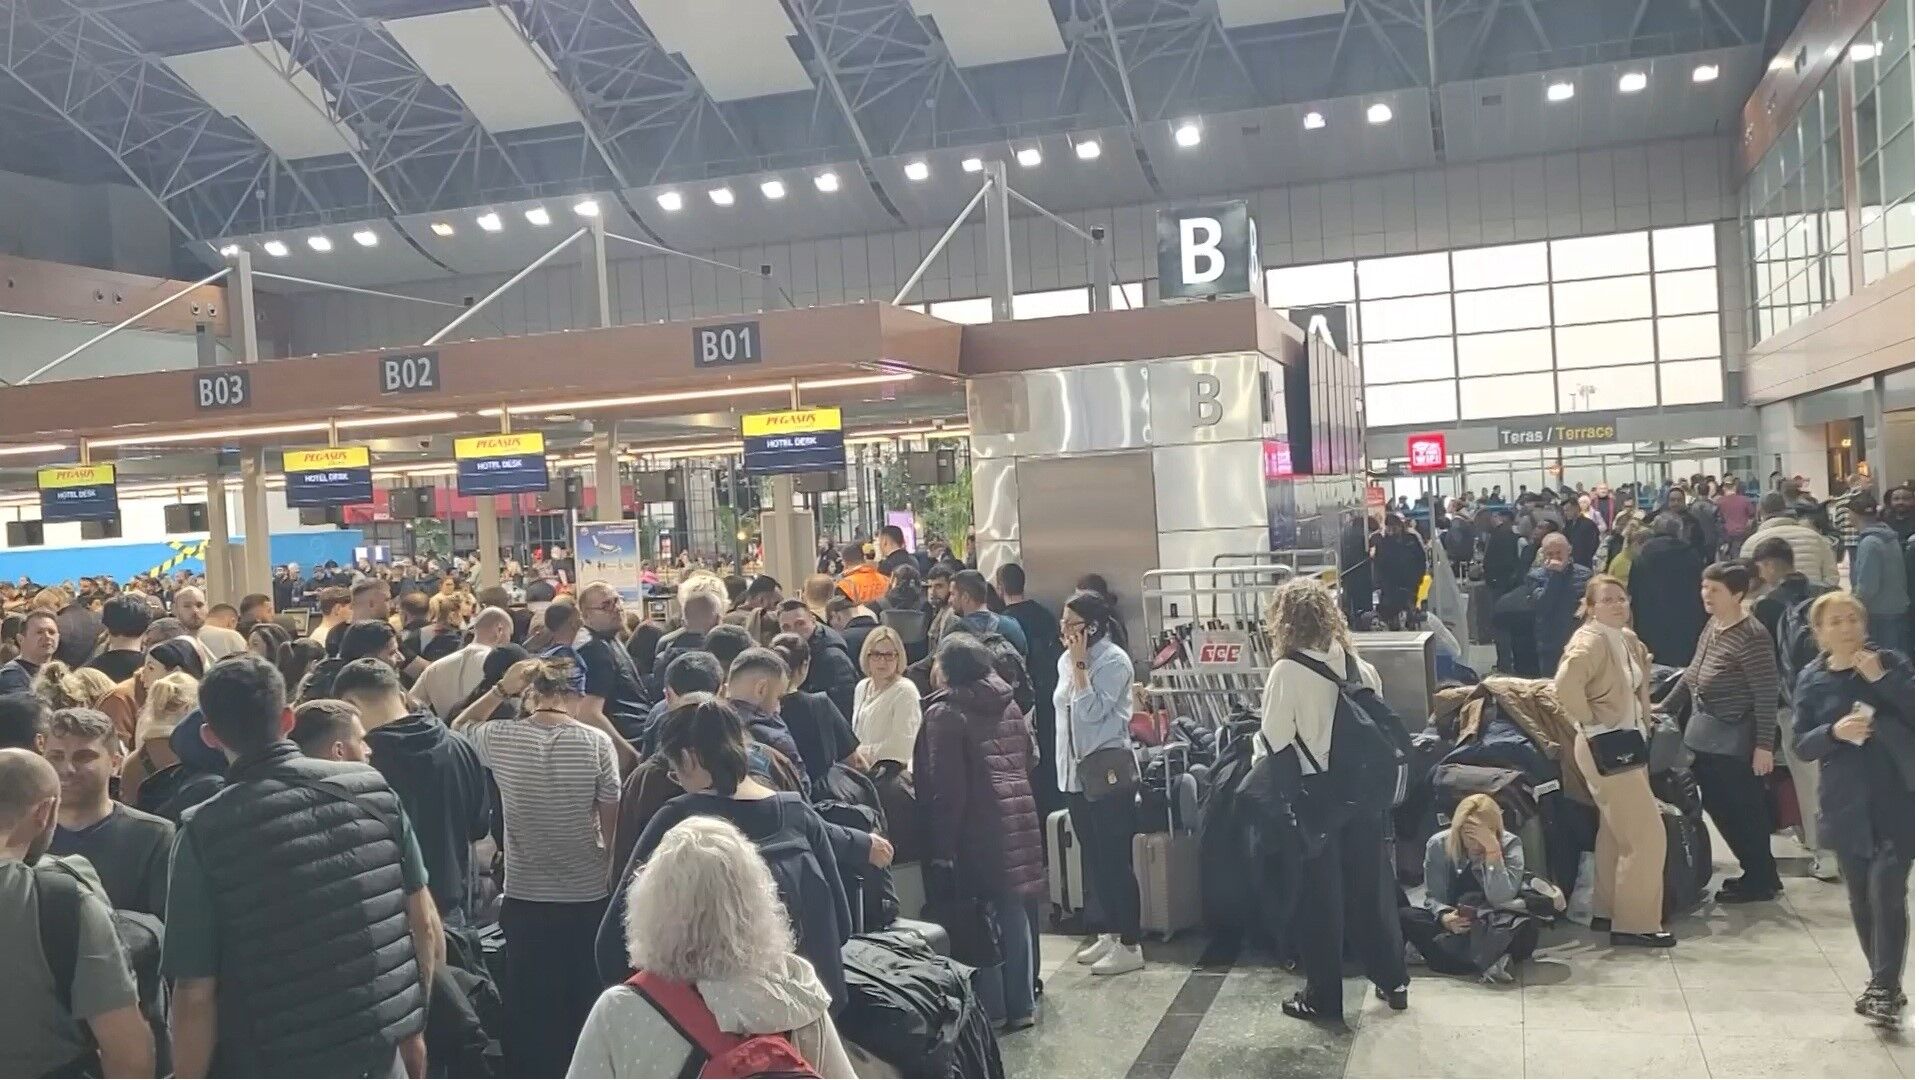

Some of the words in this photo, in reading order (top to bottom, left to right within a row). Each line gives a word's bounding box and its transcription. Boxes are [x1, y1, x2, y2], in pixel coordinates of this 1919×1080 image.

[1179, 217, 1226, 284] B
[701, 327, 751, 362] B01
[385, 357, 432, 390] B02
[199, 375, 244, 406] B03
[1189, 373, 1223, 427] B
[766, 414, 816, 425] PEGASUS
[476, 438, 521, 448] PEGASUS
[1501, 430, 1543, 444] Teras
[1547, 427, 1553, 442] /
[1556, 426, 1613, 440] Terrace
[304, 452, 347, 462] PEGASUS
[56, 469, 95, 480] PEGASUS
